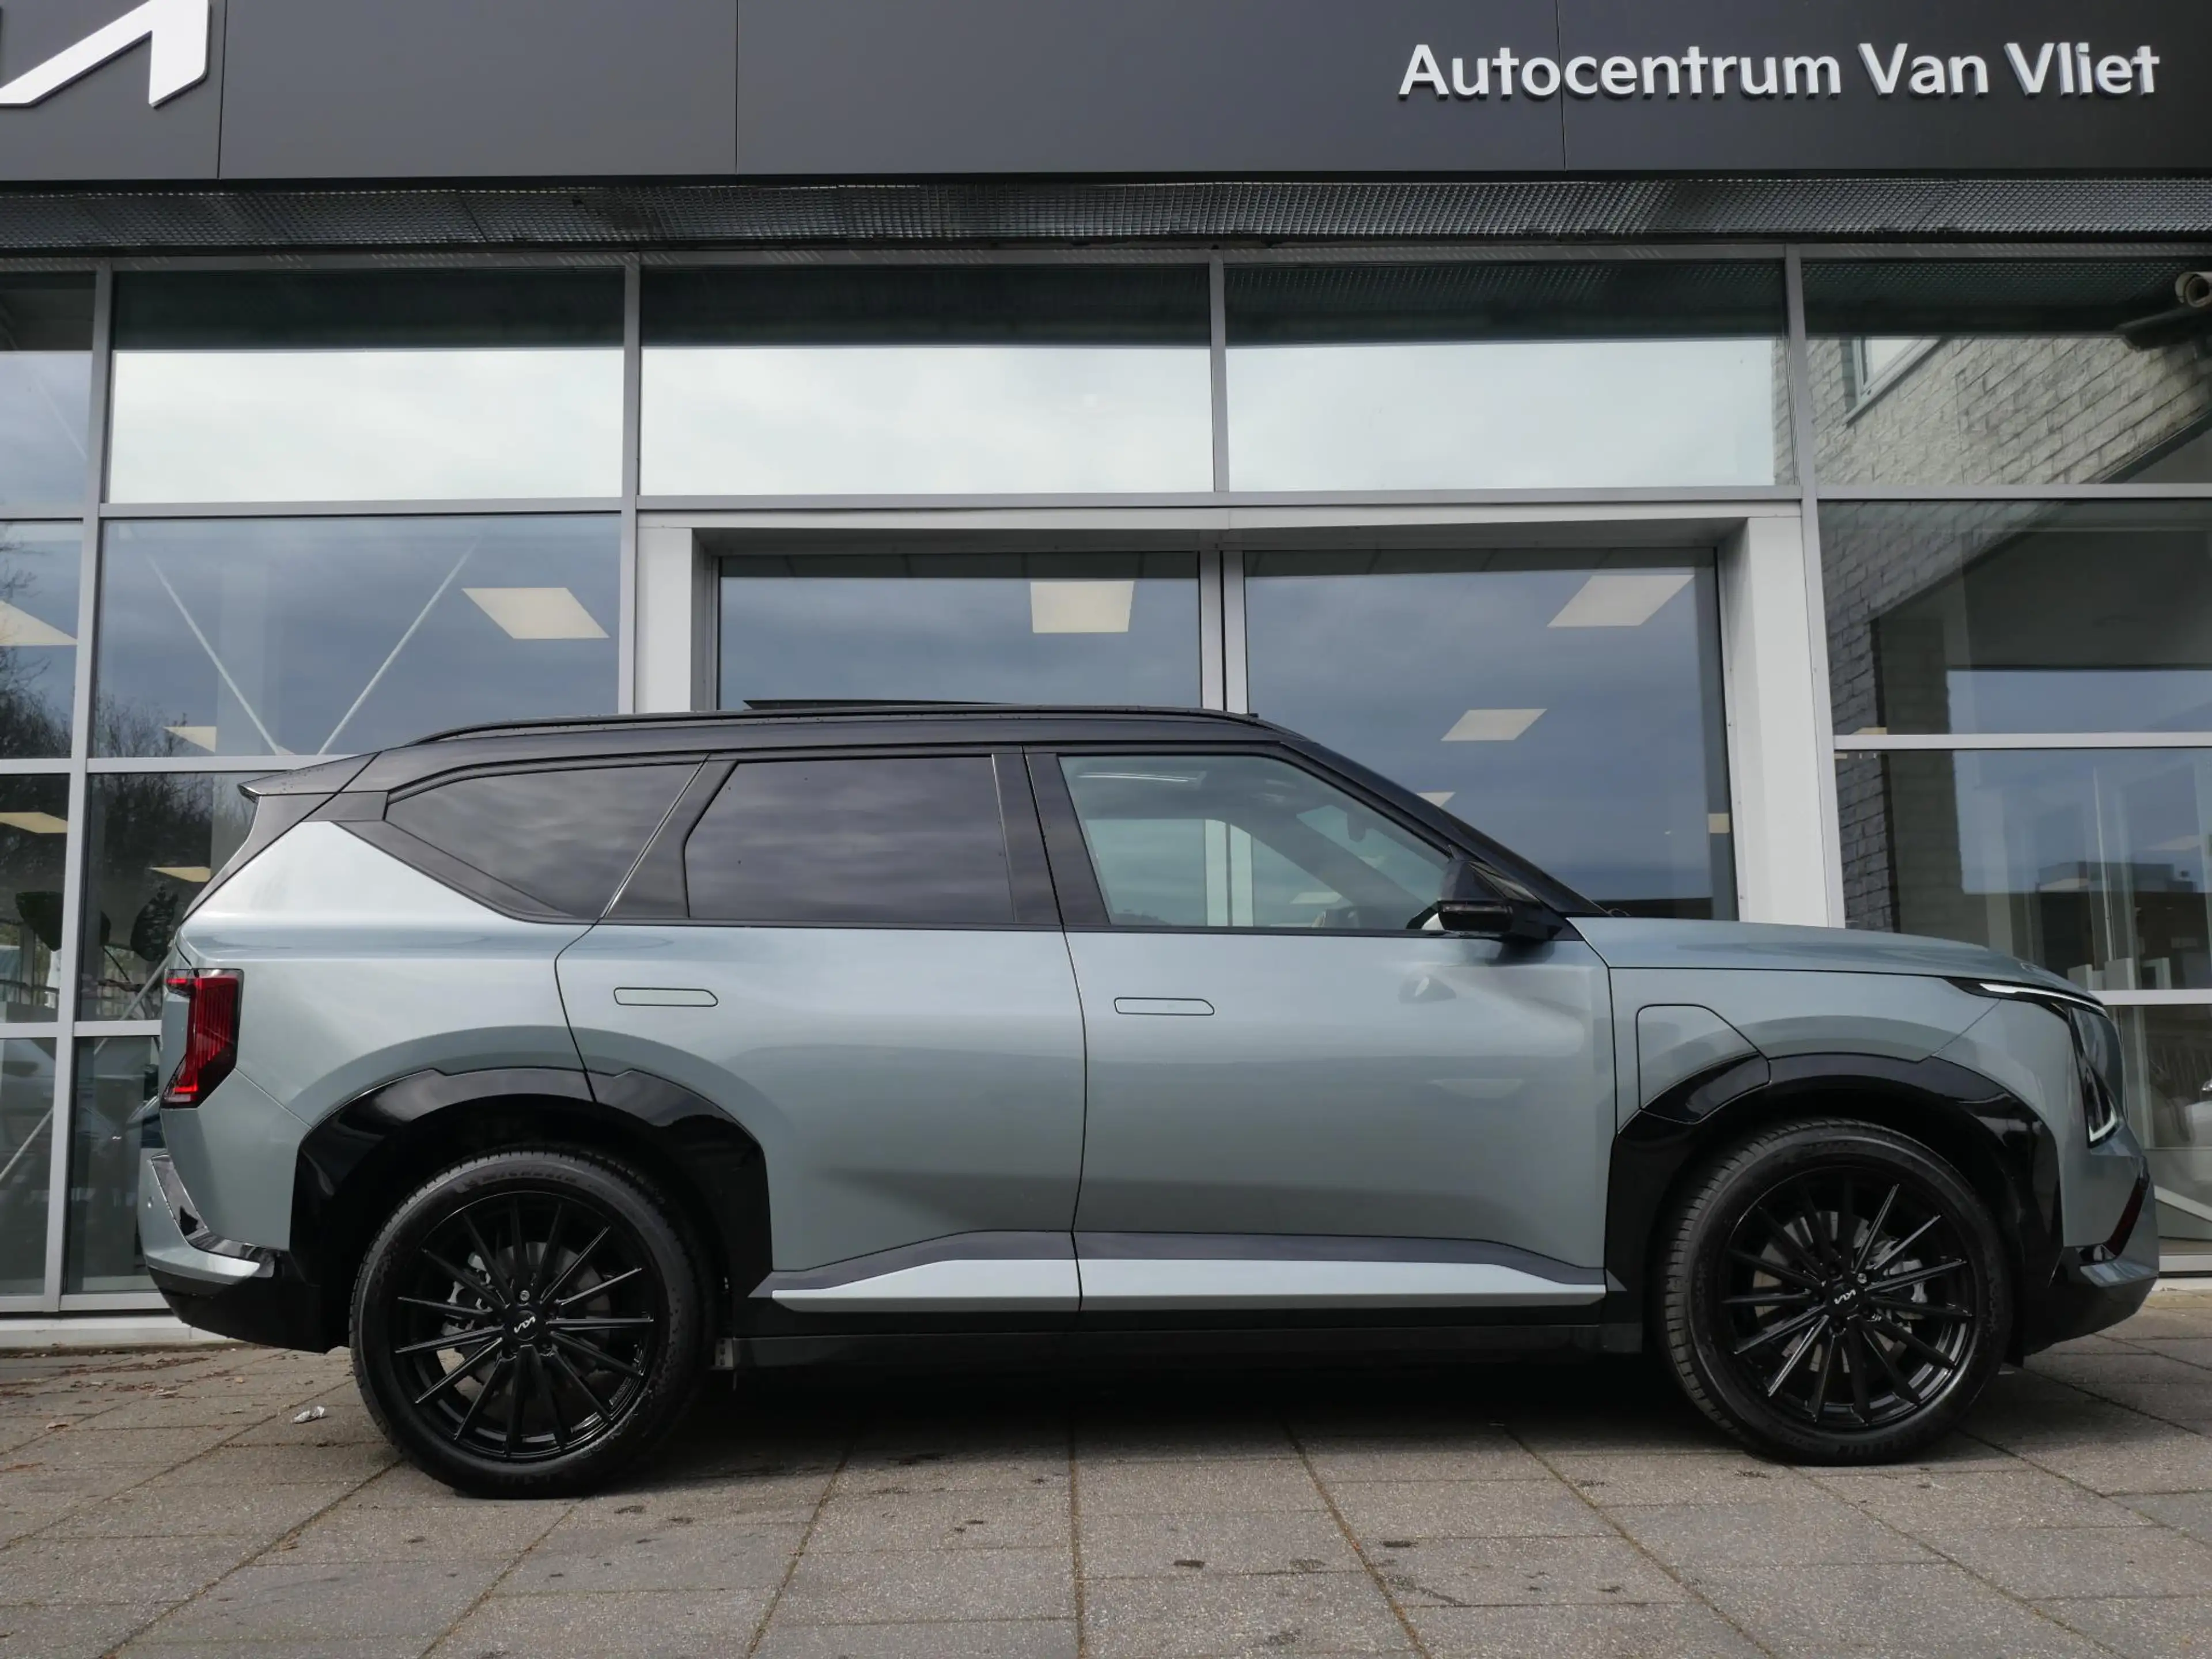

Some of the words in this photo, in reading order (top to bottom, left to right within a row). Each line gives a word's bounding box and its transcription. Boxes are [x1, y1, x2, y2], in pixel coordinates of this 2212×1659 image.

[1399, 43, 1842, 99] Autocentrum
[1858, 43, 1989, 97] Van
[2003, 41, 2160, 96] Vliet
